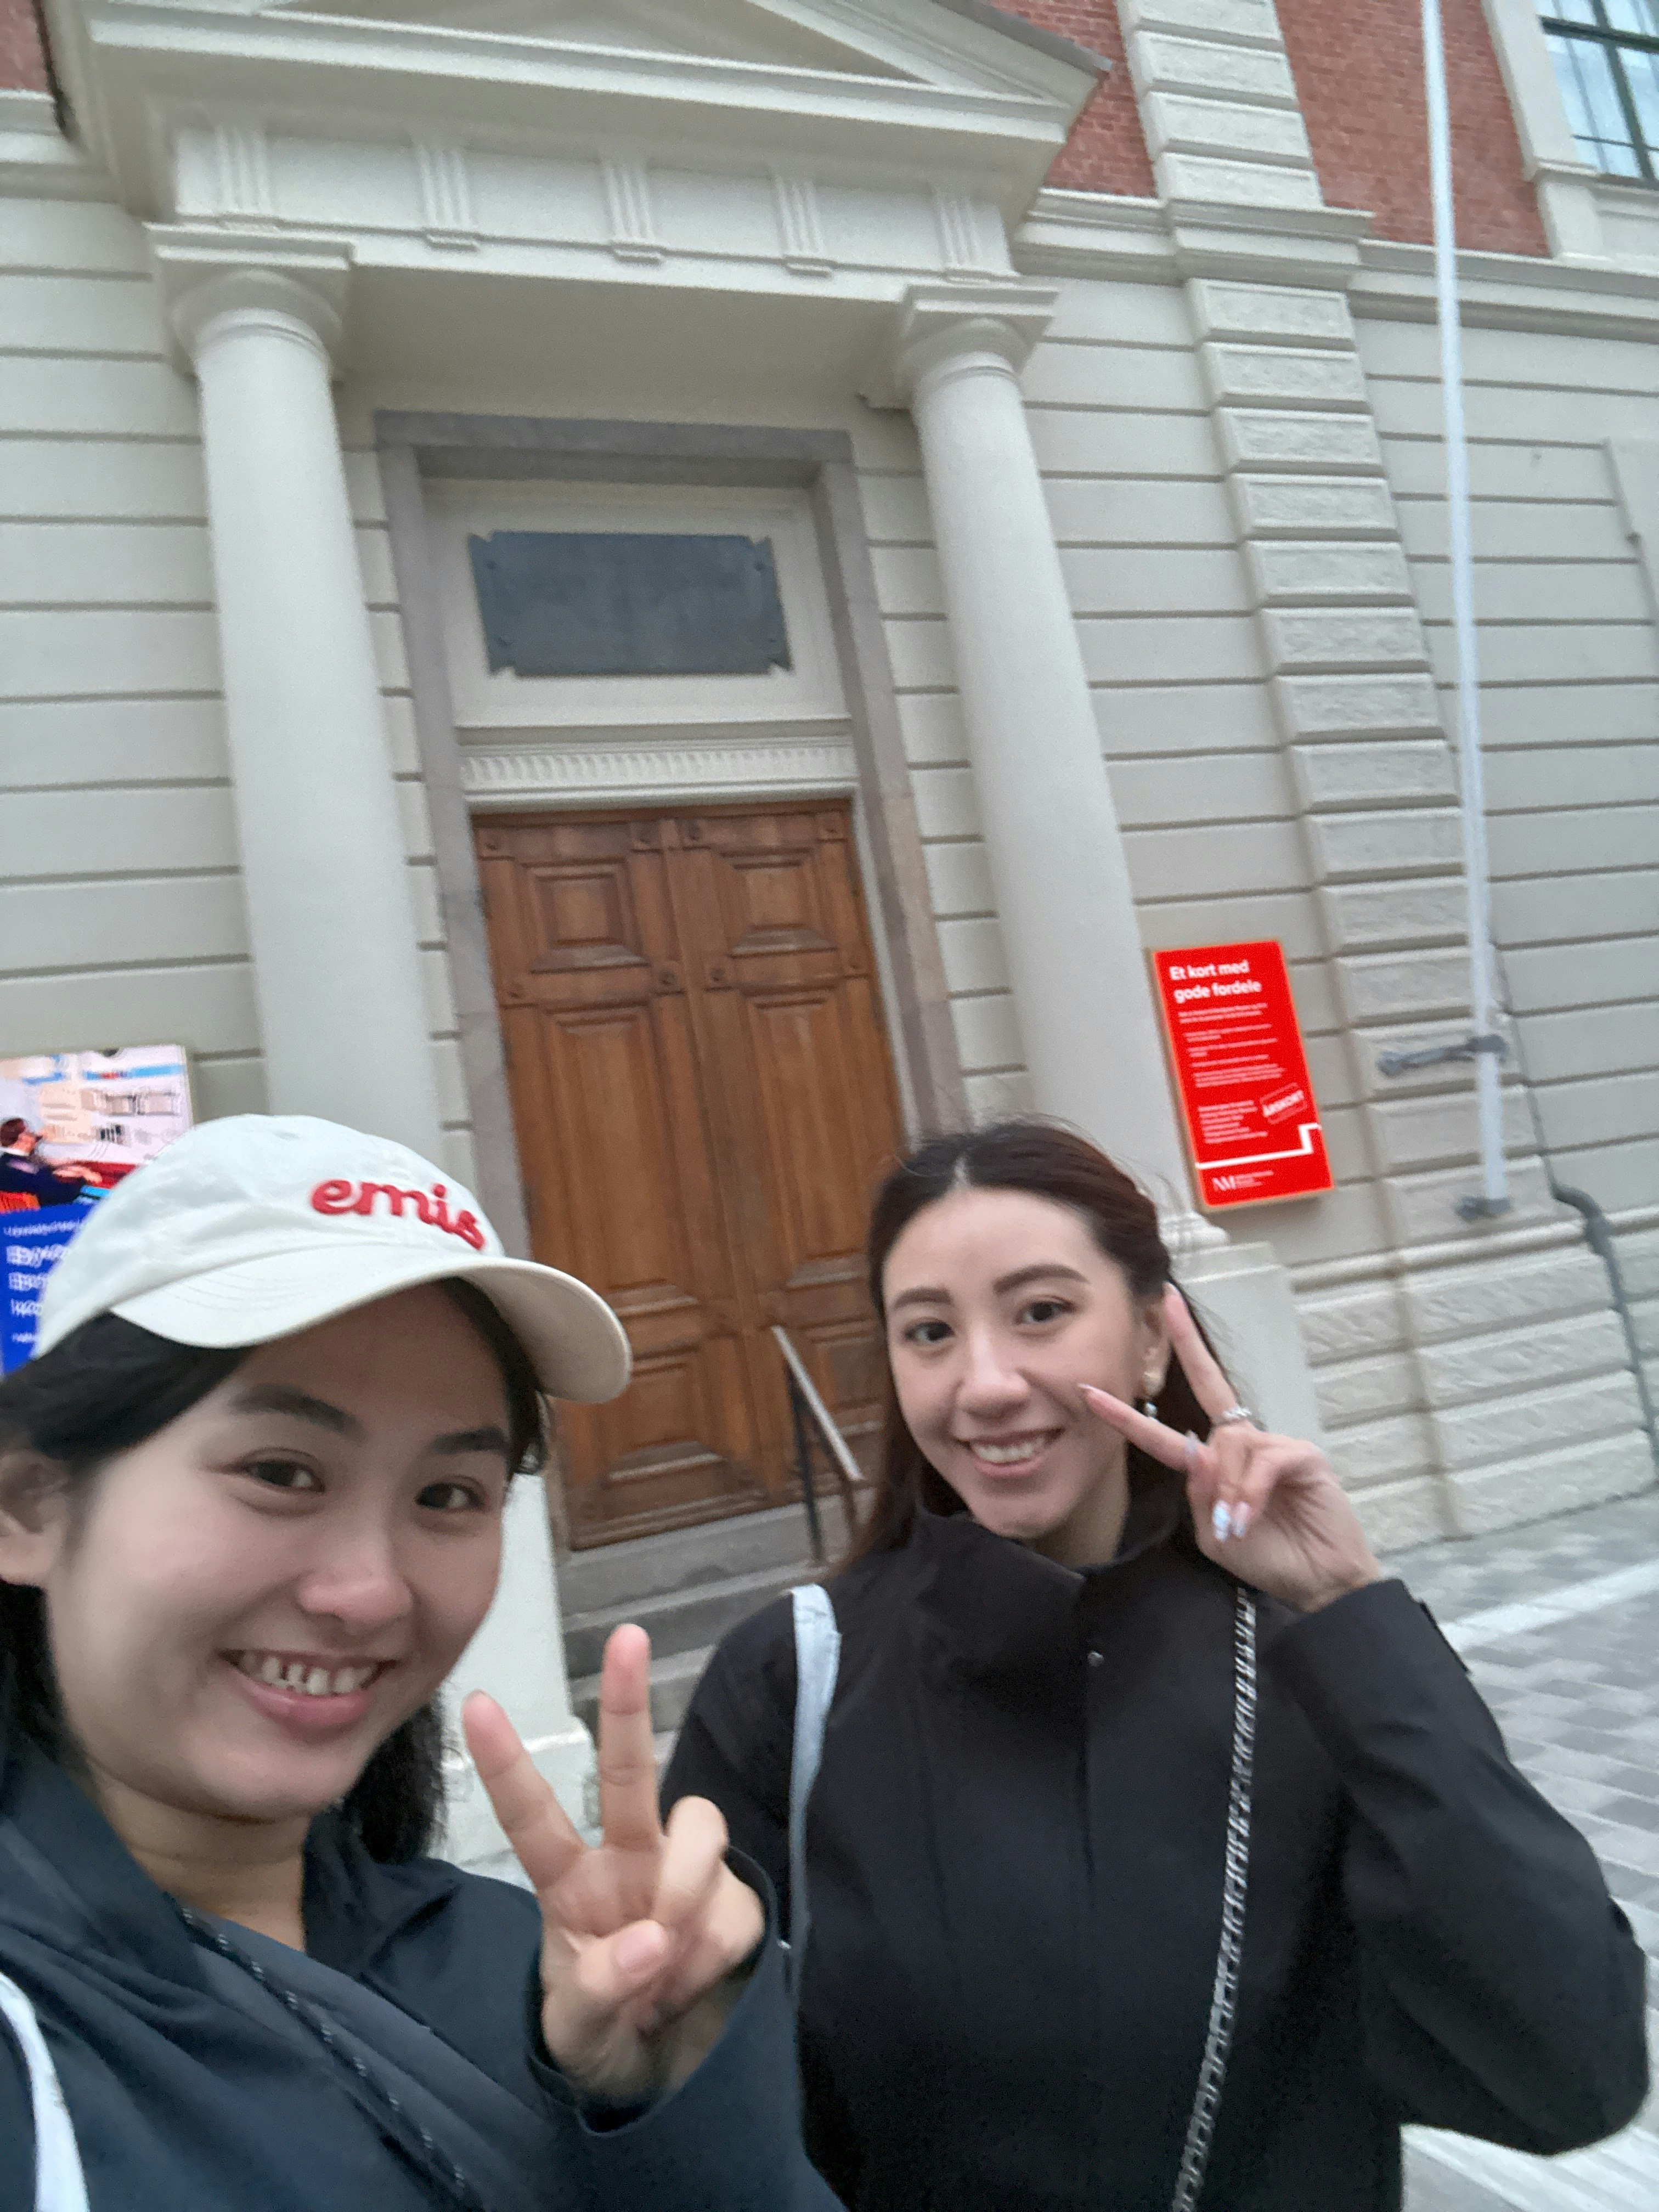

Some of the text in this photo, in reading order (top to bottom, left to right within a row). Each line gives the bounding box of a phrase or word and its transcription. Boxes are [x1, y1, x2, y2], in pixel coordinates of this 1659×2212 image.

[1169, 959, 1250, 980] Et kort med
[1173, 979, 1262, 1004] gode fordele
[311, 1178, 486, 1251] emis
